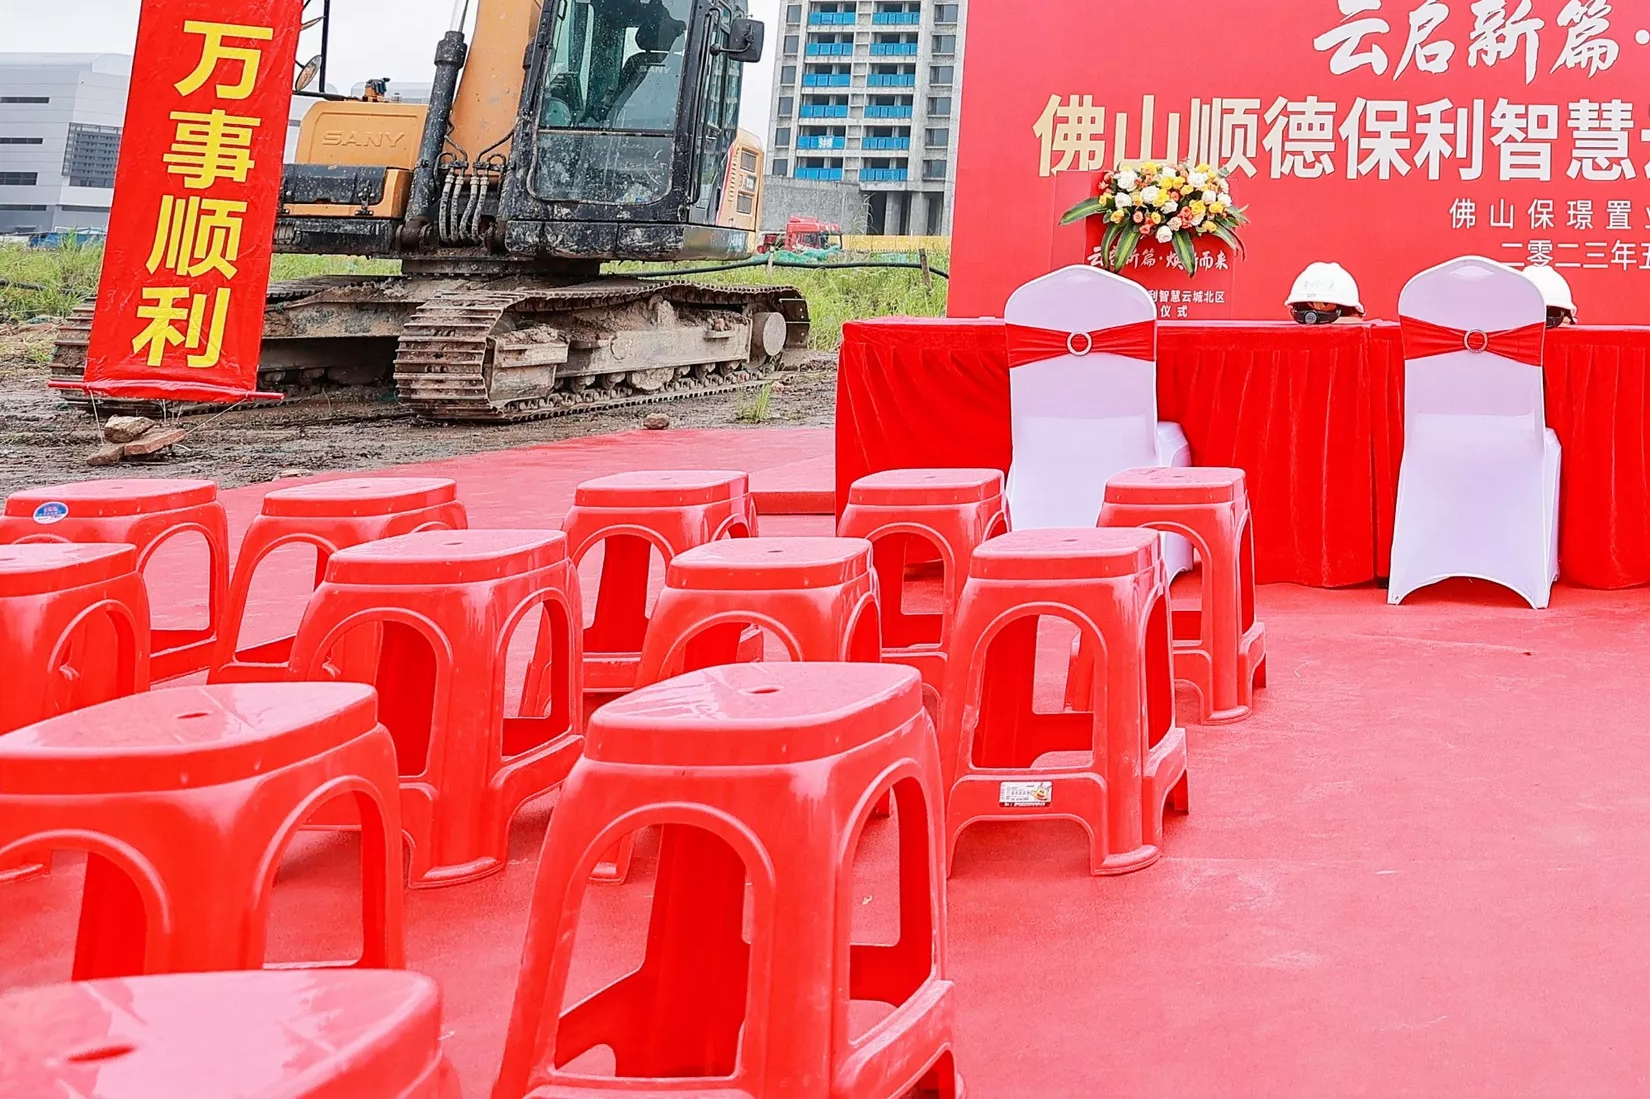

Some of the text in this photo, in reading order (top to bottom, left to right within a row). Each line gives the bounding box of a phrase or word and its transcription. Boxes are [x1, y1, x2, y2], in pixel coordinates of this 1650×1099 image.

[132, 19, 275, 368] 万事顺利
[322, 129, 405, 148] SANY
